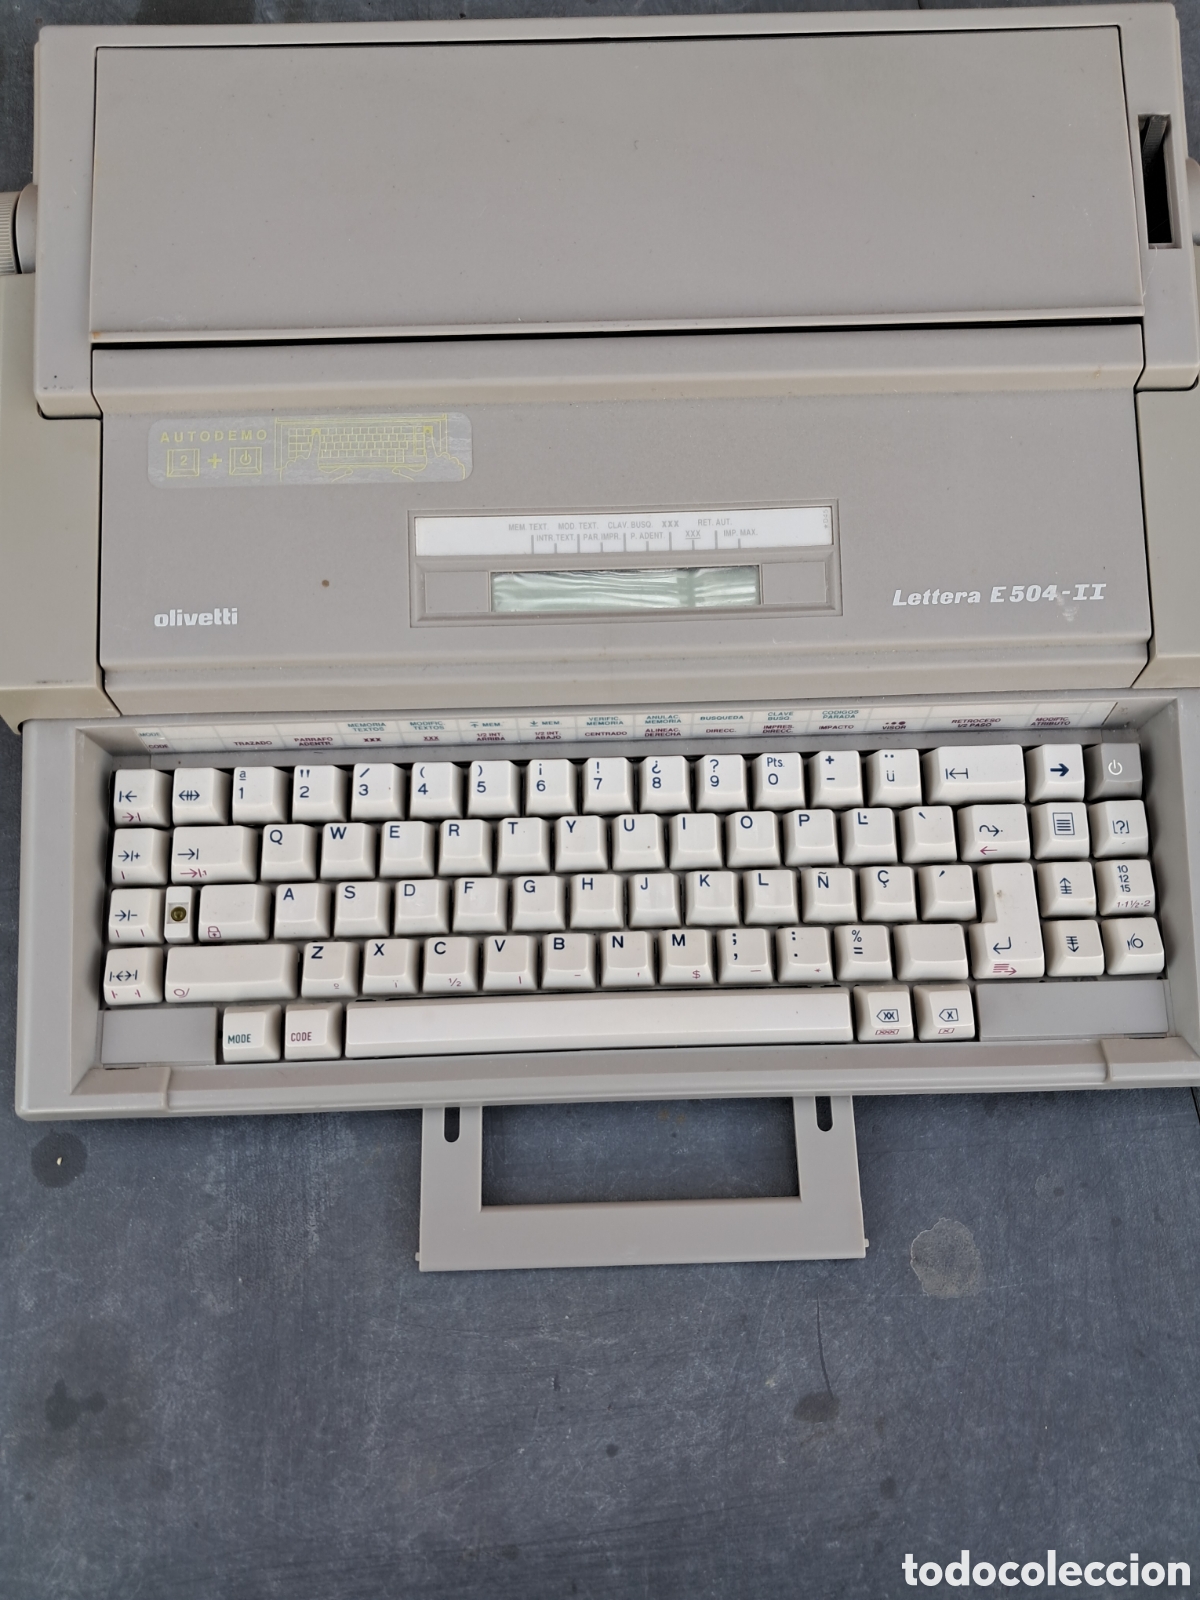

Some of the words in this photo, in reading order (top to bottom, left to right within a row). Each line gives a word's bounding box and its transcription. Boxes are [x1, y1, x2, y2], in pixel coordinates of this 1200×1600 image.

[160, 429, 267, 443] AUTODEMO
[508, 523, 527, 531] MEM.
[529, 523, 549, 531] TEXT.
[558, 522, 577, 530] MOD.
[579, 522, 599, 530] TEXT.
[607, 521, 629, 529] CLAV.
[662, 520, 679, 528] XXX
[697, 518, 714, 526] RET.
[715, 518, 733, 526] AUT.
[639, 532, 665, 540] ADENT.
[723, 529, 739, 537] IMP.
[740, 528, 759, 536] MAX.
[892, 588, 981, 606] Lettera
[154, 607, 238, 627] olivetti
[476, 781, 487, 793] 5
[536, 779, 546, 792] 6
[593, 777, 603, 790] 7
[651, 776, 662, 789] 8
[709, 775, 720, 787] 9
[238, 787, 244, 800] 1
[299, 786, 310, 798] 2
[358, 784, 369, 796] 3
[417, 783, 429, 795] 4
[566, 820, 577, 833] Y
[623, 818, 635, 832] U
[740, 815, 753, 829] O
[798, 813, 810, 827] P
[330, 826, 347, 840] W
[389, 825, 401, 839] E
[448, 823, 460, 837] R
[507, 821, 518, 835] T
[269, 829, 283, 846] Q
[1117, 864, 1129, 874] 10
[582, 877, 594, 891] H
[640, 877, 649, 890] J
[699, 874, 711, 887] K
[758, 872, 769, 886] L
[817, 871, 830, 889] Ñ
[877, 869, 890, 888] Ç
[1118, 874, 1130, 883] 12
[344, 885, 356, 899] S
[404, 883, 416, 897] D
[464, 881, 475, 894] F
[523, 879, 536, 893] G
[1120, 884, 1131, 893] 15
[283, 887, 295, 901] A
[611, 935, 624, 949] N
[671, 933, 686, 947] M
[851, 929, 863, 943] %
[373, 943, 386, 956] X
[434, 941, 447, 955] C
[494, 939, 506, 953] V
[553, 937, 565, 950] B
[310, 946, 324, 959] Z
[227, 1033, 252, 1045] MODE
[290, 1031, 312, 1042] CODE
